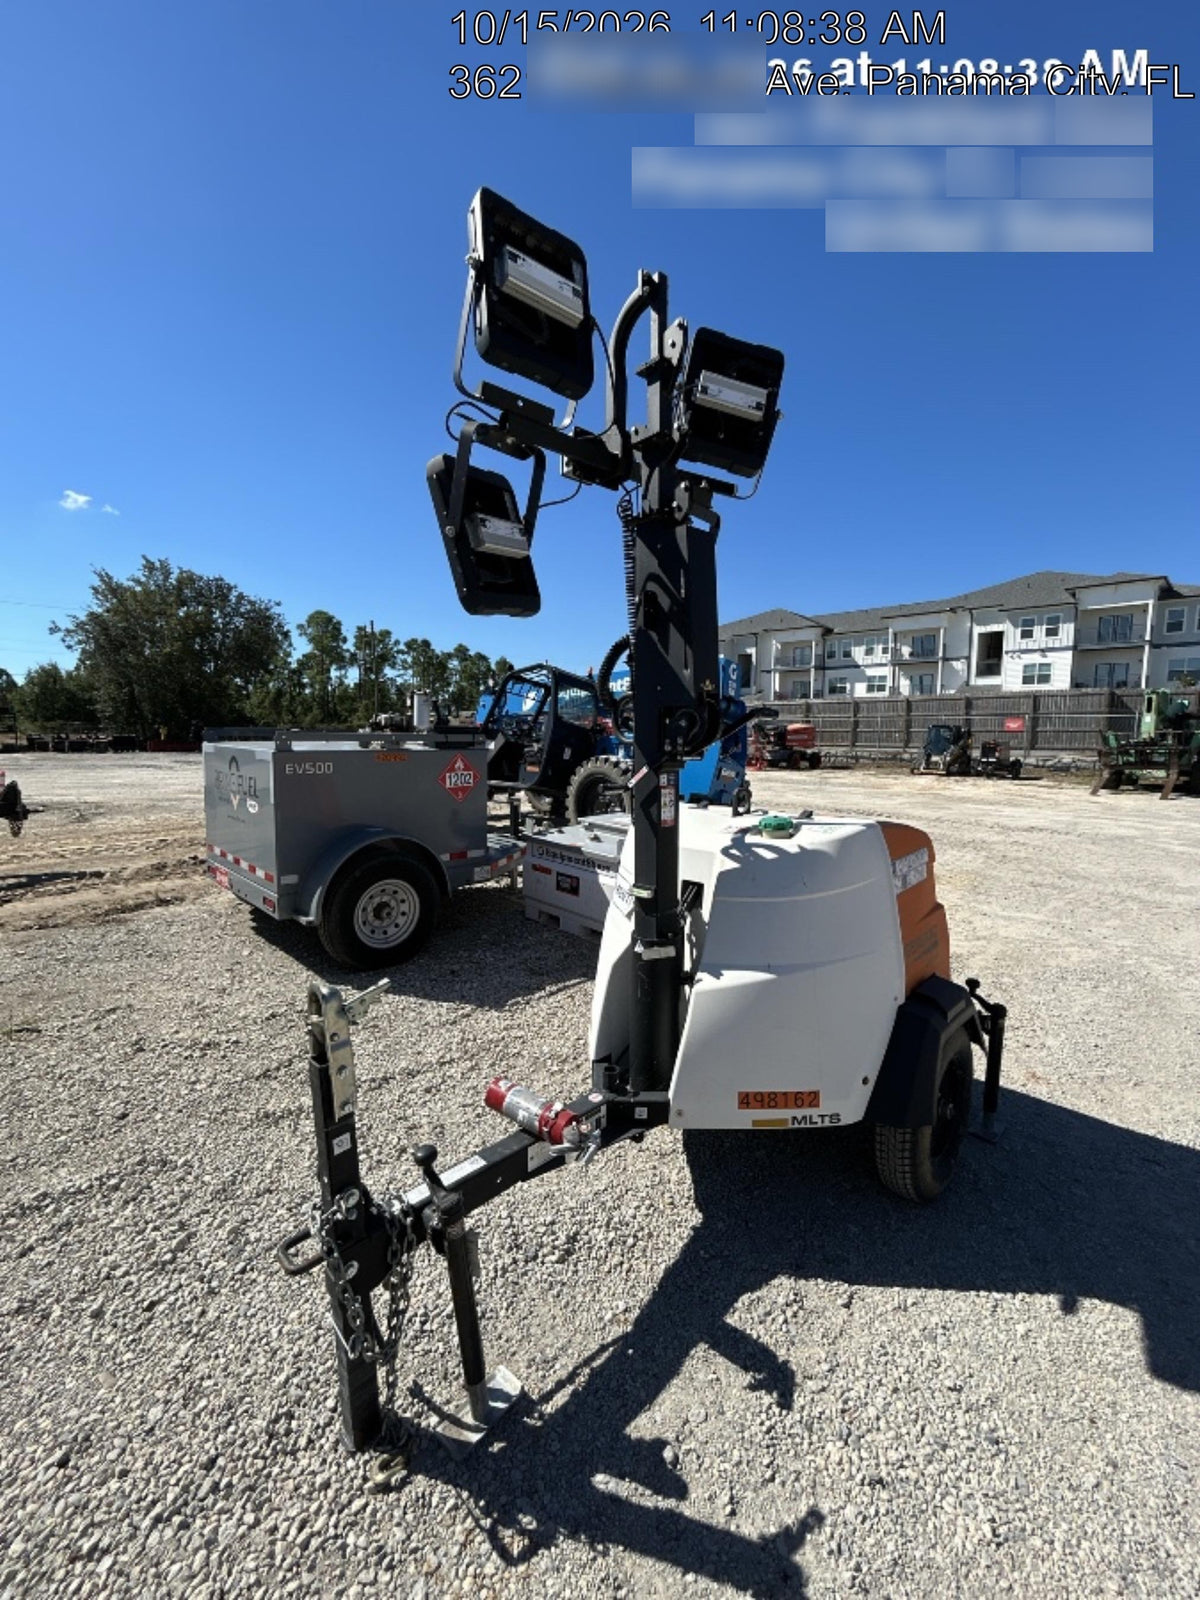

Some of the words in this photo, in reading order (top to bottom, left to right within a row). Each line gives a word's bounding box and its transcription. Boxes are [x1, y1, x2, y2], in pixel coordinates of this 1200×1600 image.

[285, 761, 334, 775] EV500
[447, 772, 473, 788] 1202
[738, 1091, 819, 1109] 498162
[791, 1113, 842, 1126] MLTS
